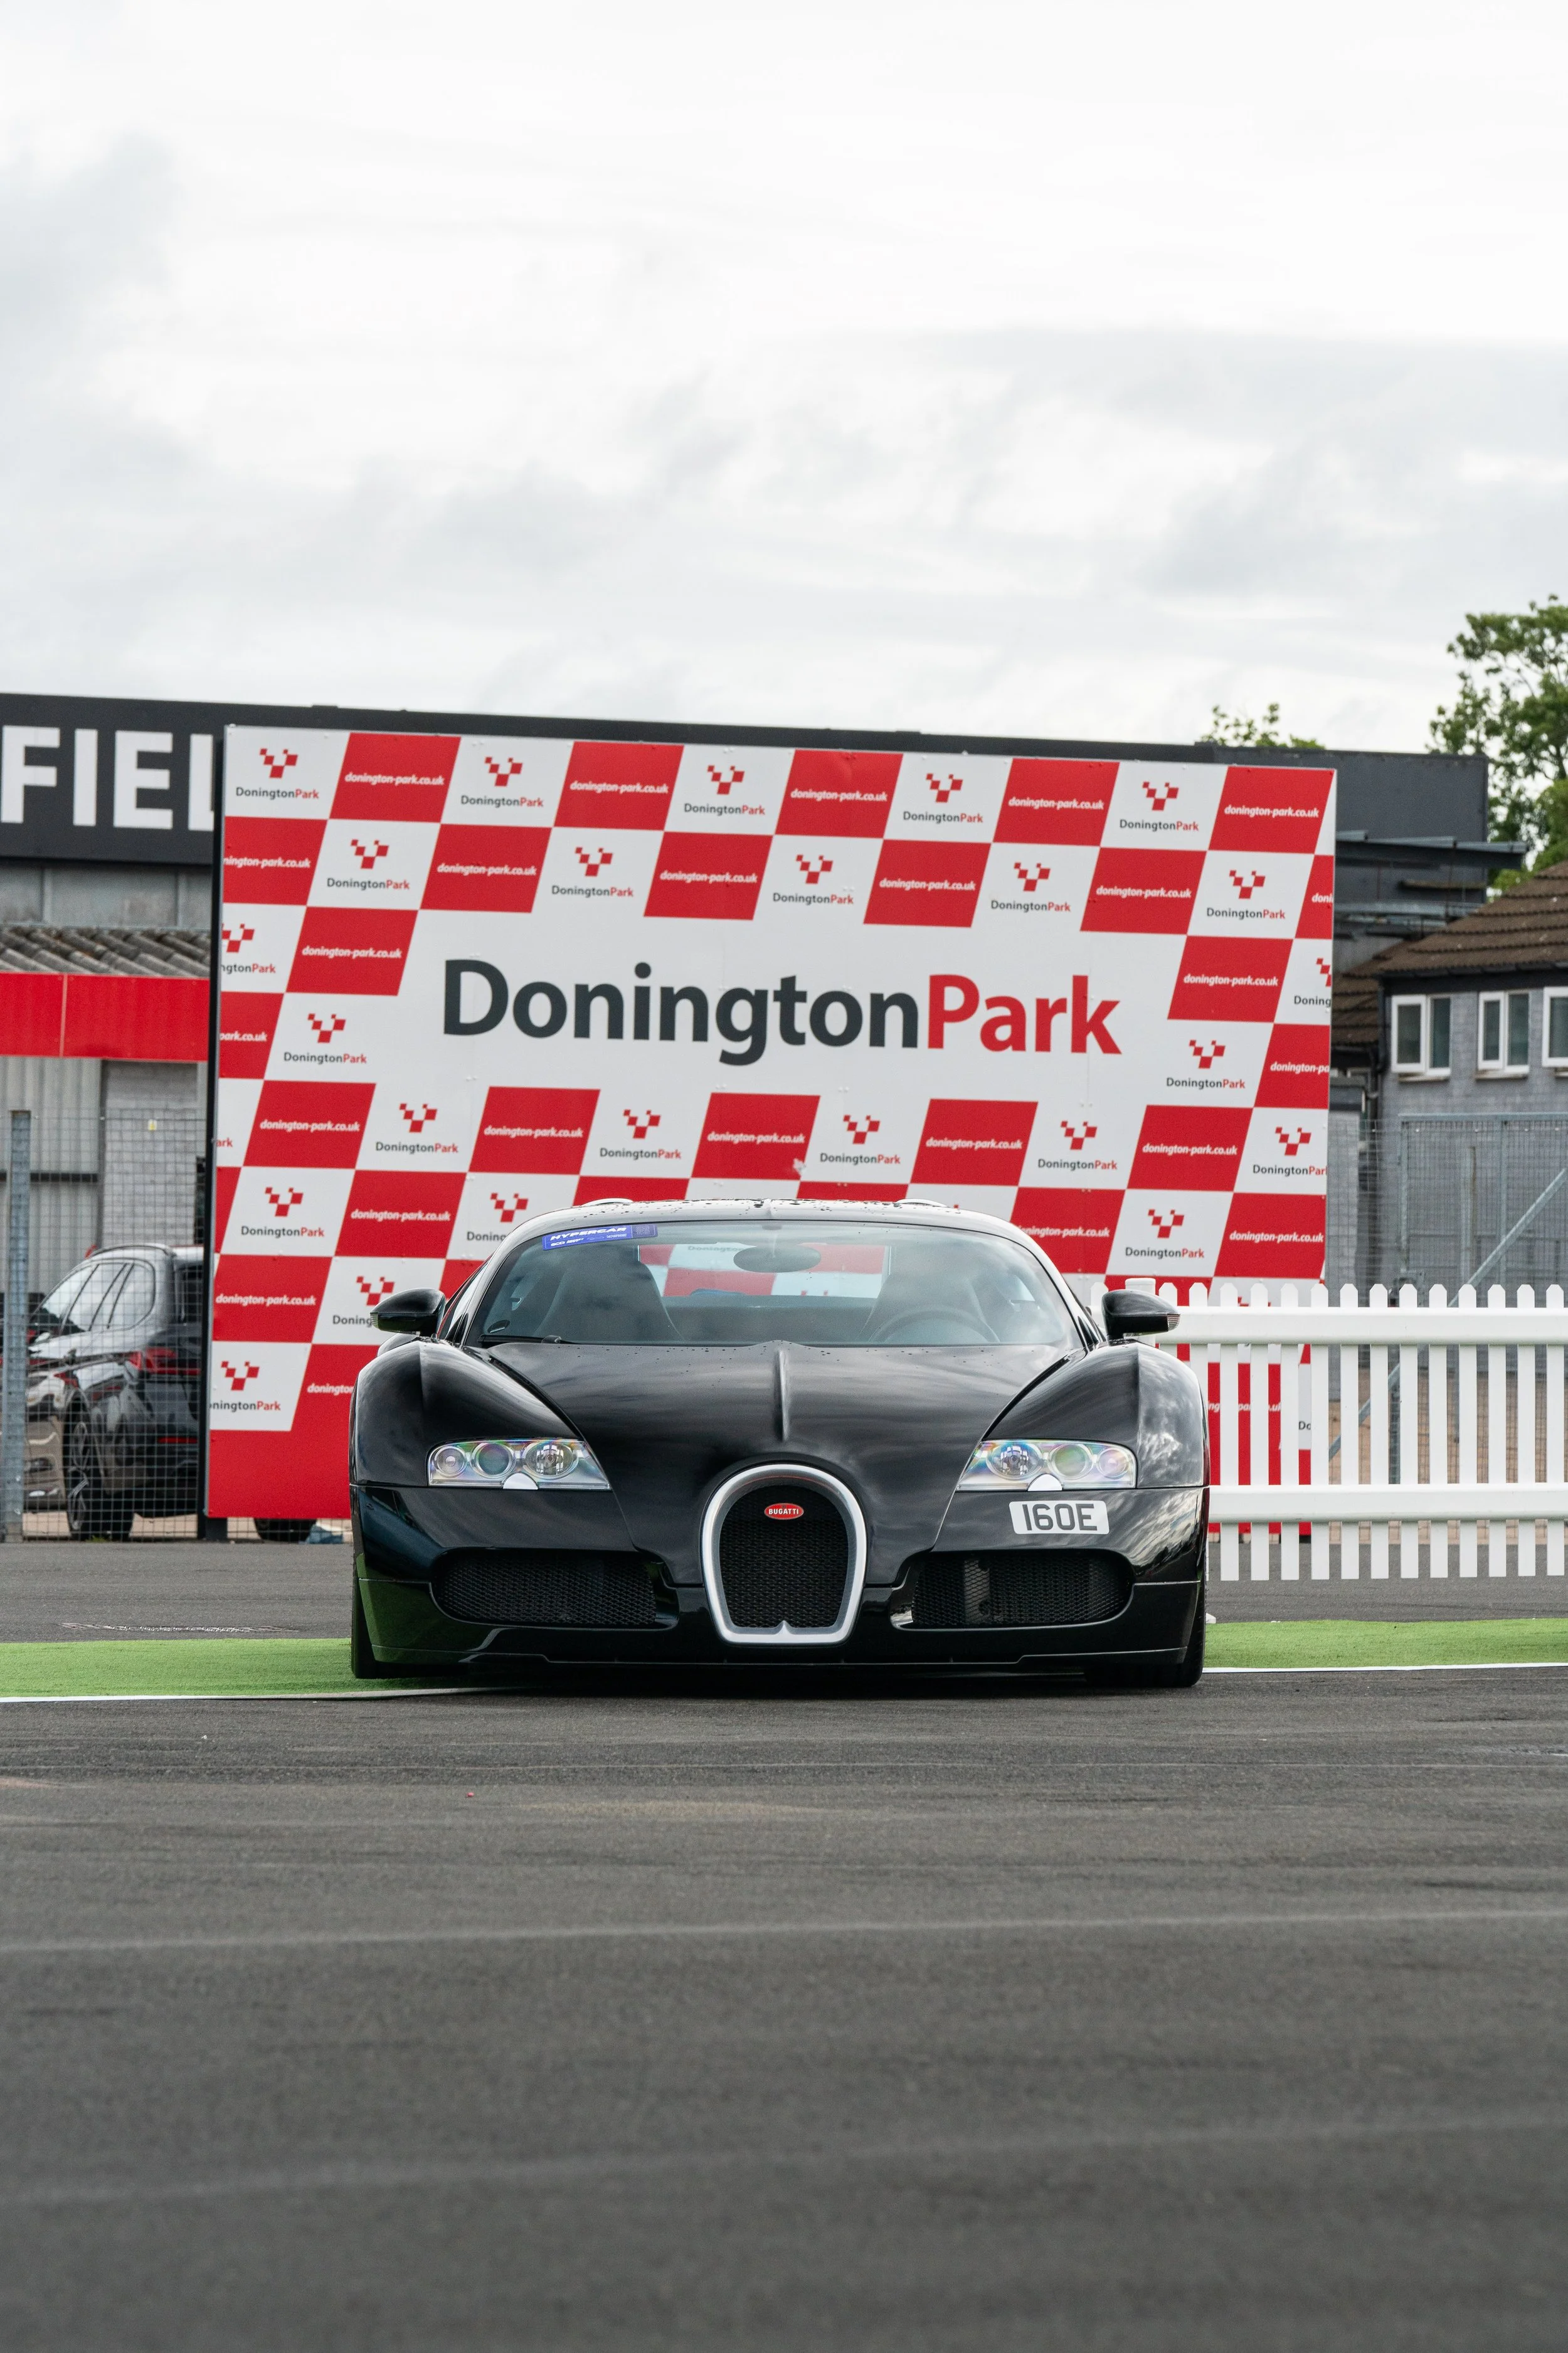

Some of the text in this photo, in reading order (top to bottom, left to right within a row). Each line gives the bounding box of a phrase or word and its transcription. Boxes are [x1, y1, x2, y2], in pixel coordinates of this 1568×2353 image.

[345, 772, 444, 785] donington-park.co.uk
[236, 787, 319, 800] DoningtonPark
[570, 780, 669, 794] donington-park.co.uk
[461, 795, 543, 808] DoningtonPark
[790, 789, 887, 802] donington-park.co.uk
[684, 803, 765, 816] DoningtonPark
[1009, 797, 1104, 810] donington-park.co.uk
[903, 811, 983, 824] DoningtonPark
[1224, 805, 1319, 818] donington-park.co.uk
[1120, 819, 1199, 832] DoningtonPark
[437, 863, 536, 876] donington-park.co.uk
[660, 870, 758, 884] donington-park.co.uk
[327, 878, 410, 891] DoningtonPark
[879, 878, 976, 891] donington-park.co.uk
[552, 885, 633, 898] DoningtonPark
[1096, 885, 1192, 899] donington-park.co.uk
[773, 893, 853, 905] DoningtonPark
[991, 900, 1070, 913] DoningtonPark
[1207, 908, 1285, 920] DoningtonPark
[302, 945, 402, 959] donington-park.co.uk
[1184, 974, 1278, 987] donington-park.co.uk
[443, 959, 1122, 1066] DoningtonPark
[284, 1052, 366, 1065] DoningtonPark
[1167, 1078, 1245, 1090] DoningtonPark
[260, 1119, 360, 1133] donington-park.co.uk
[484, 1125, 583, 1139] donington-park.co.uk
[707, 1131, 805, 1144] donington-park.co.uk
[926, 1137, 1022, 1150] donington-park.co.uk
[376, 1142, 458, 1154] DoningtonPark
[600, 1148, 681, 1160] DoningtonPark
[1142, 1143, 1237, 1156] donington-park.co.uk
[820, 1153, 900, 1166] DoningtonPark
[1038, 1159, 1117, 1171] DoningtonPark
[351, 1209, 451, 1222] donington-park.co.uk
[241, 1226, 324, 1238] DoningtonPark
[550, 1227, 627, 1241] HYPERCAR
[1019, 1226, 1110, 1238] nington-park.co.uk
[1229, 1230, 1323, 1243] donington-park.co.uk
[1125, 1247, 1204, 1260] DoningtonPark
[215, 1293, 316, 1307] donington-park.co.uk
